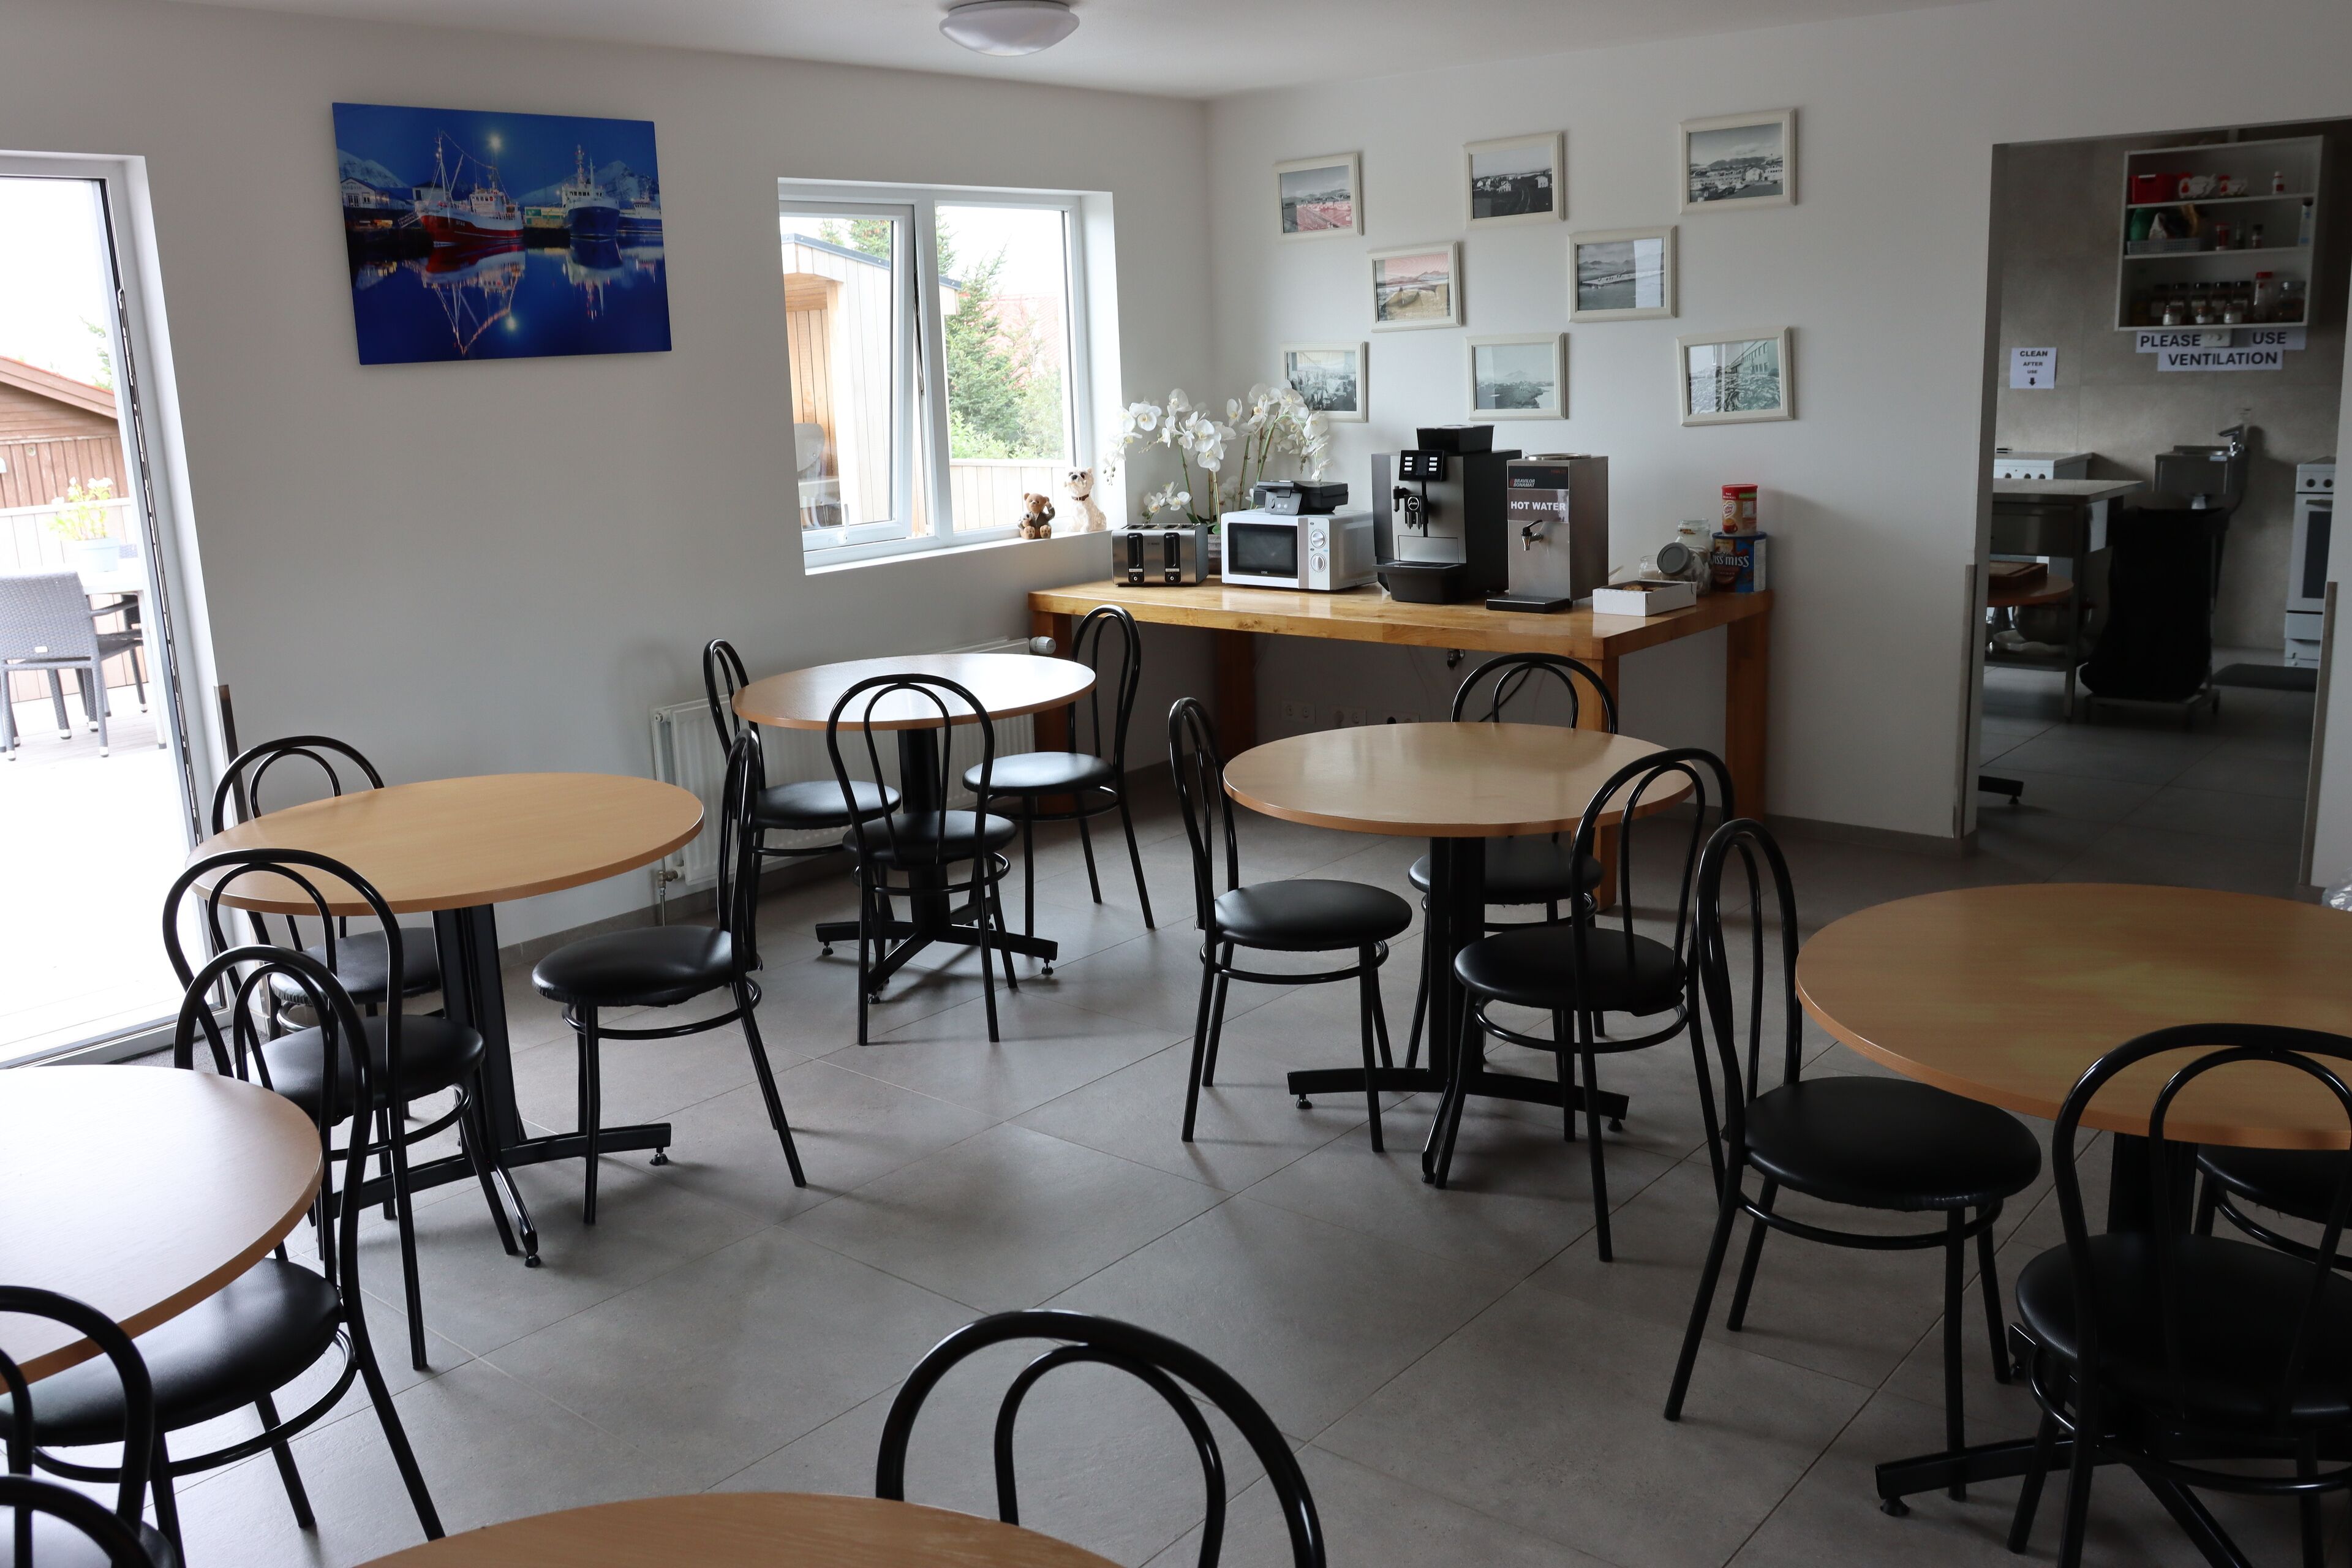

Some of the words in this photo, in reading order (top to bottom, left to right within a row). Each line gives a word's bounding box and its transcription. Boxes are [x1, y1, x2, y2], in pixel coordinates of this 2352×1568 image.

[2140, 334, 2201, 347] PLEASE
[2252, 331, 2286, 344] USE
[2168, 352, 2277, 366] VENTILATION
[1510, 501, 1529, 510] HOT
[1532, 502, 1566, 511] WATER
